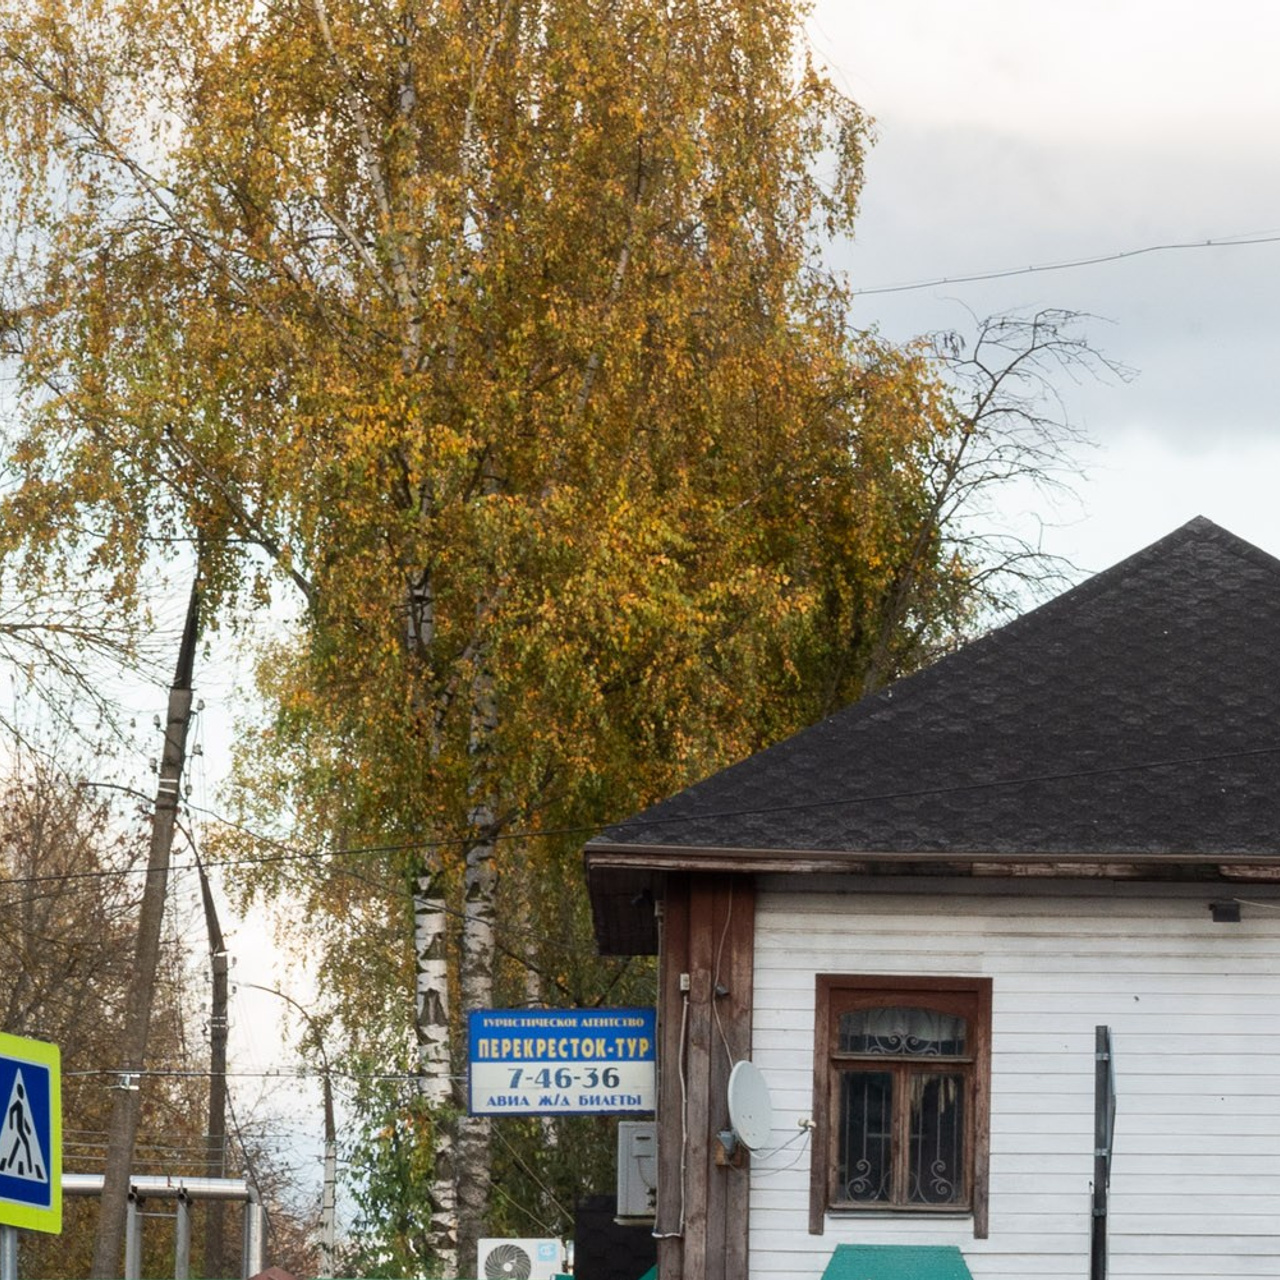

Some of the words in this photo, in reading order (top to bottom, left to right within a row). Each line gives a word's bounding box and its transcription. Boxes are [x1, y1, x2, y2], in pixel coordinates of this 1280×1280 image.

[483, 1017, 577, 1028] ТУРИСТИЧЕСКОЕ
[581, 1017, 645, 1028] АГЕНТСТВО
[478, 1037, 650, 1059] ПЕРЕКРЕСТОК-ТУР
[507, 1066, 620, 1089] 7-46-36
[486, 1095, 530, 1107] АВИА
[538, 1093, 571, 1107] Ж/Д
[579, 1094, 642, 1106] БИЛЕТЫ
